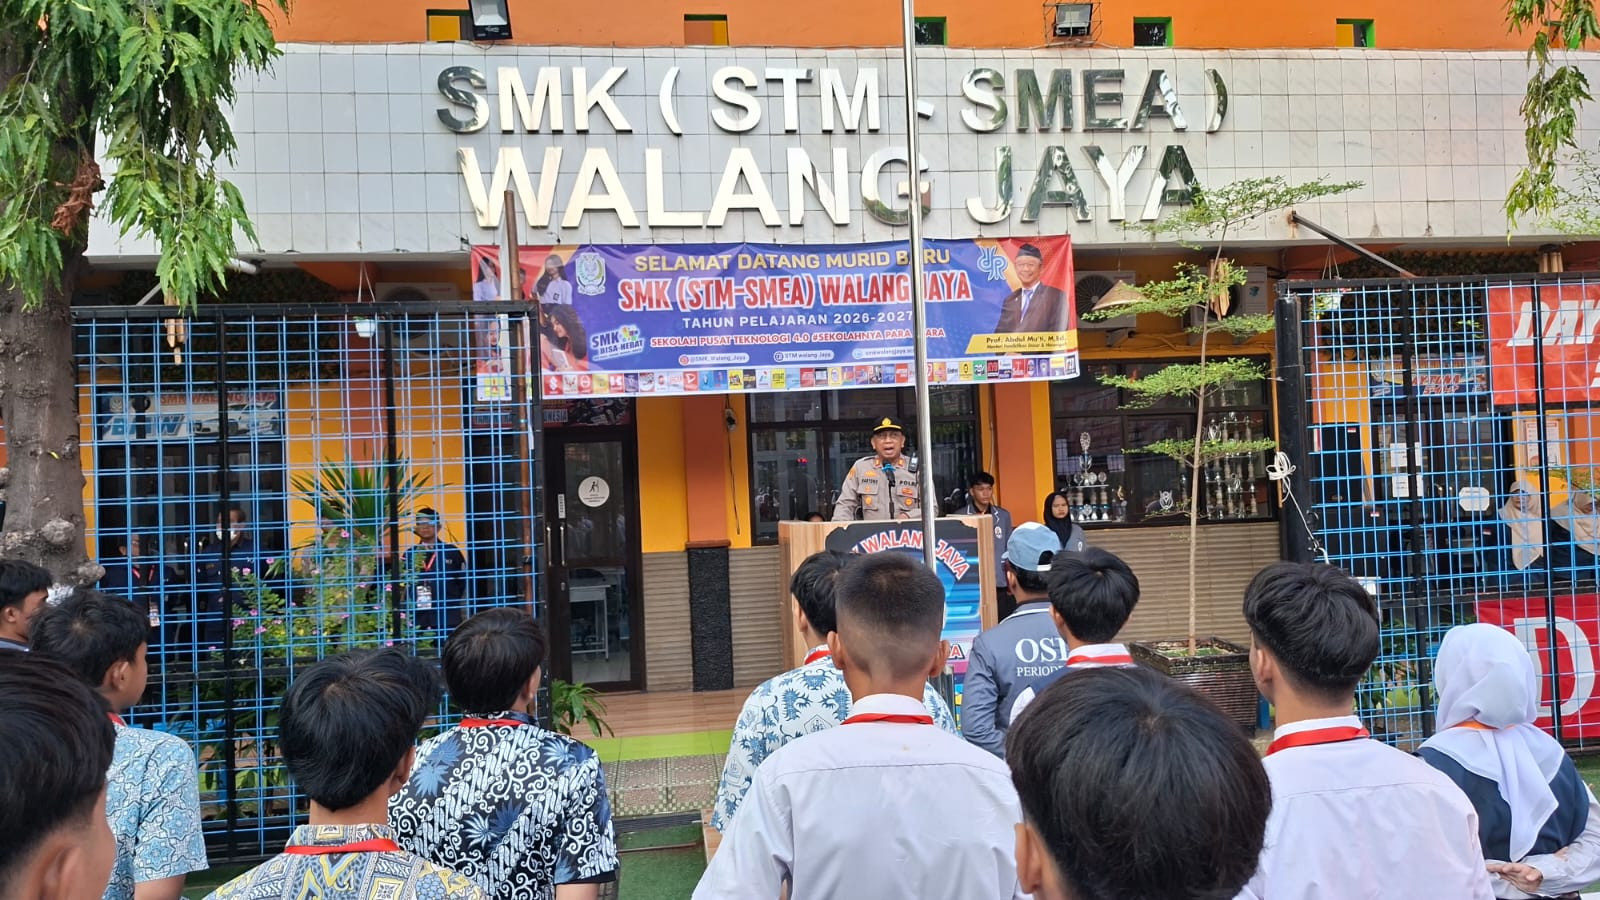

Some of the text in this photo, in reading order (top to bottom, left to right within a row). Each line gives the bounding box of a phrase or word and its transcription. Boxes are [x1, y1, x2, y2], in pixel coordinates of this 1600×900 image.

[436, 65, 633, 135] SMK
[711, 66, 881, 133] STM
[960, 67, 1189, 133] SMEA
[457, 144, 1204, 229] WALANG JAYA
[635, 248, 951, 272] SELAMAT DATANG MURID BRU
[618, 277, 673, 311] SMK
[676, 272, 816, 312] (STM-SMEA)
[818, 272, 912, 306] WALANG
[683, 311, 914, 329] TAHUN PELAJARAN 2026-2027
[591, 331, 619, 348] SMK
[650, 327, 946, 347] SEKOLAH PUSAT TEKNOLOGI 4.0 #SEKOLAHNYA PARA ARA
[860, 529, 970, 581] WALAN JAYA
[1015, 637, 1068, 663] OSI
[1016, 664, 1064, 678] PERIO
